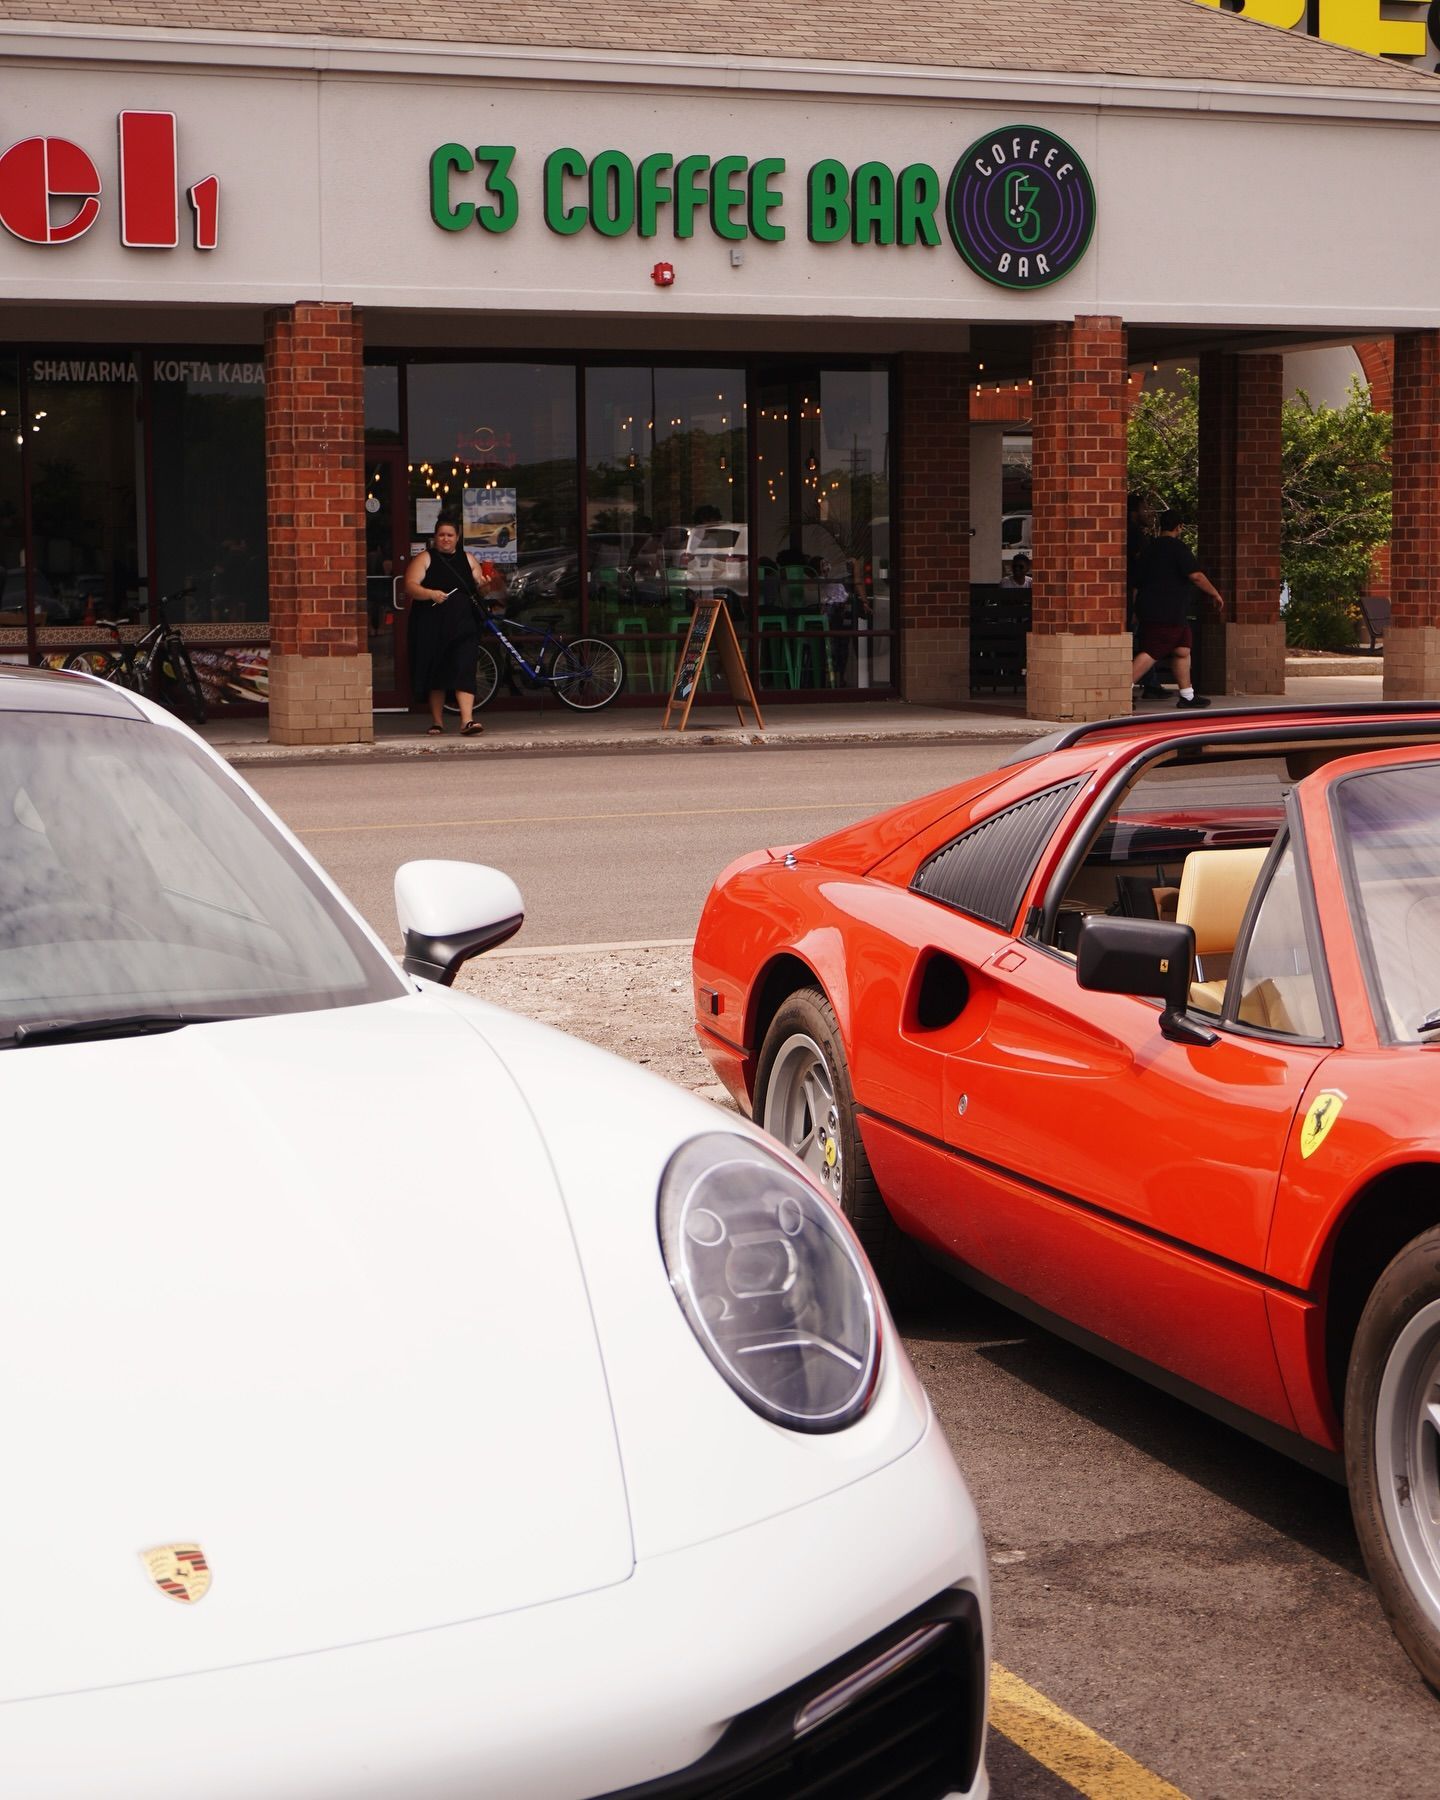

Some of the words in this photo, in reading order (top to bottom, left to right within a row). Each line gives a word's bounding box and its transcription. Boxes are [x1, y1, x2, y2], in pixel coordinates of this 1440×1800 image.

[975, 138, 1073, 180] COFFEE
[430, 142, 518, 233] C3
[543, 148, 785, 242] COFFEE
[807, 159, 942, 245] BAR
[998, 253, 1050, 277] BAR
[33, 360, 138, 382] SHAWARMA
[153, 361, 212, 382] KOFTA
